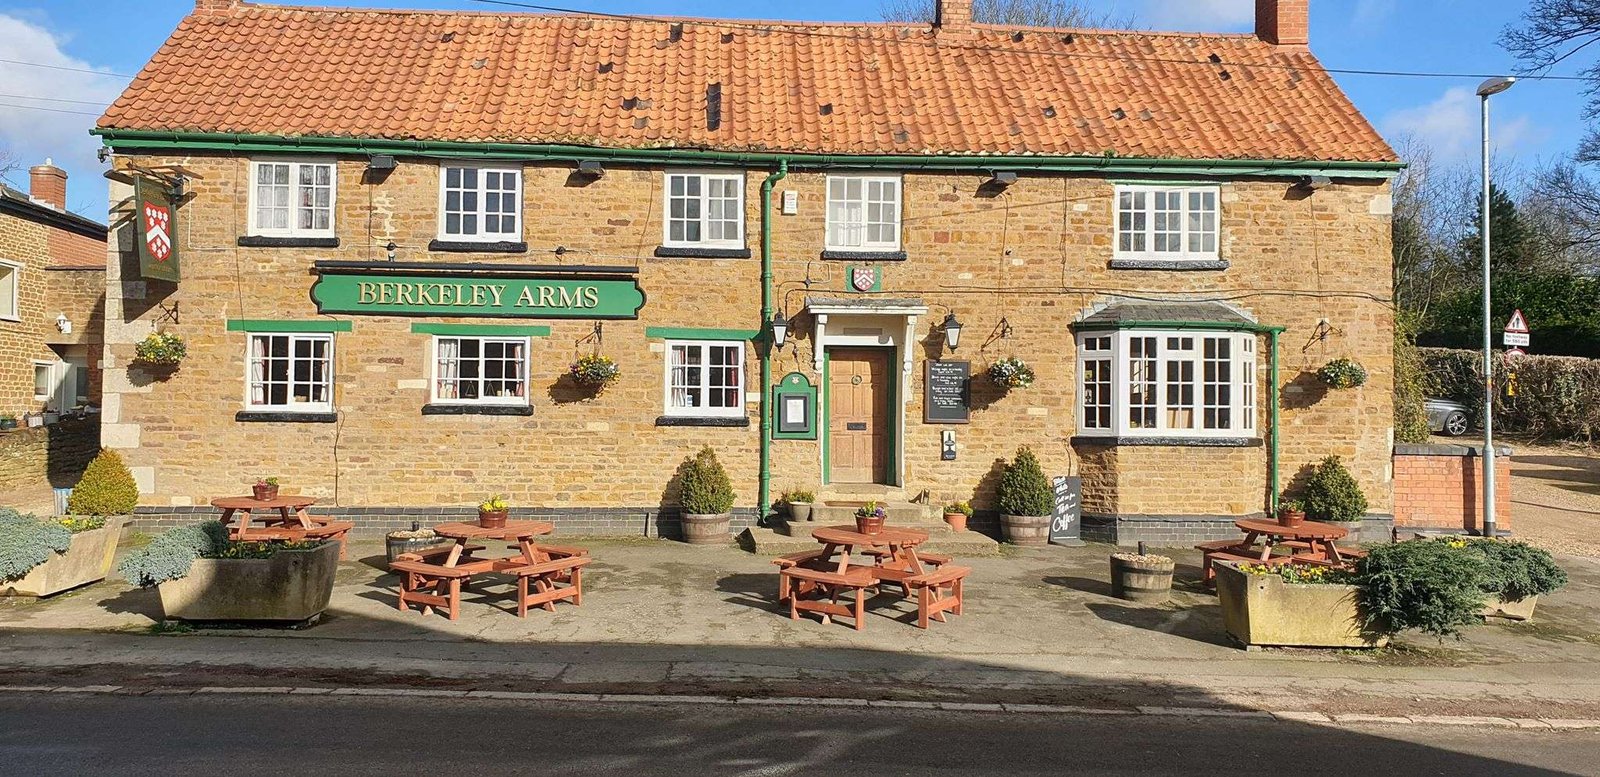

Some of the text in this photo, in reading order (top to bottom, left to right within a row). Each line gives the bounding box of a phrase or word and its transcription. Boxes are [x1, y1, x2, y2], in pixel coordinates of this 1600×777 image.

[357, 281, 599, 309] BERKELEY ARMS
[1052, 513, 1075, 532] Coffee
